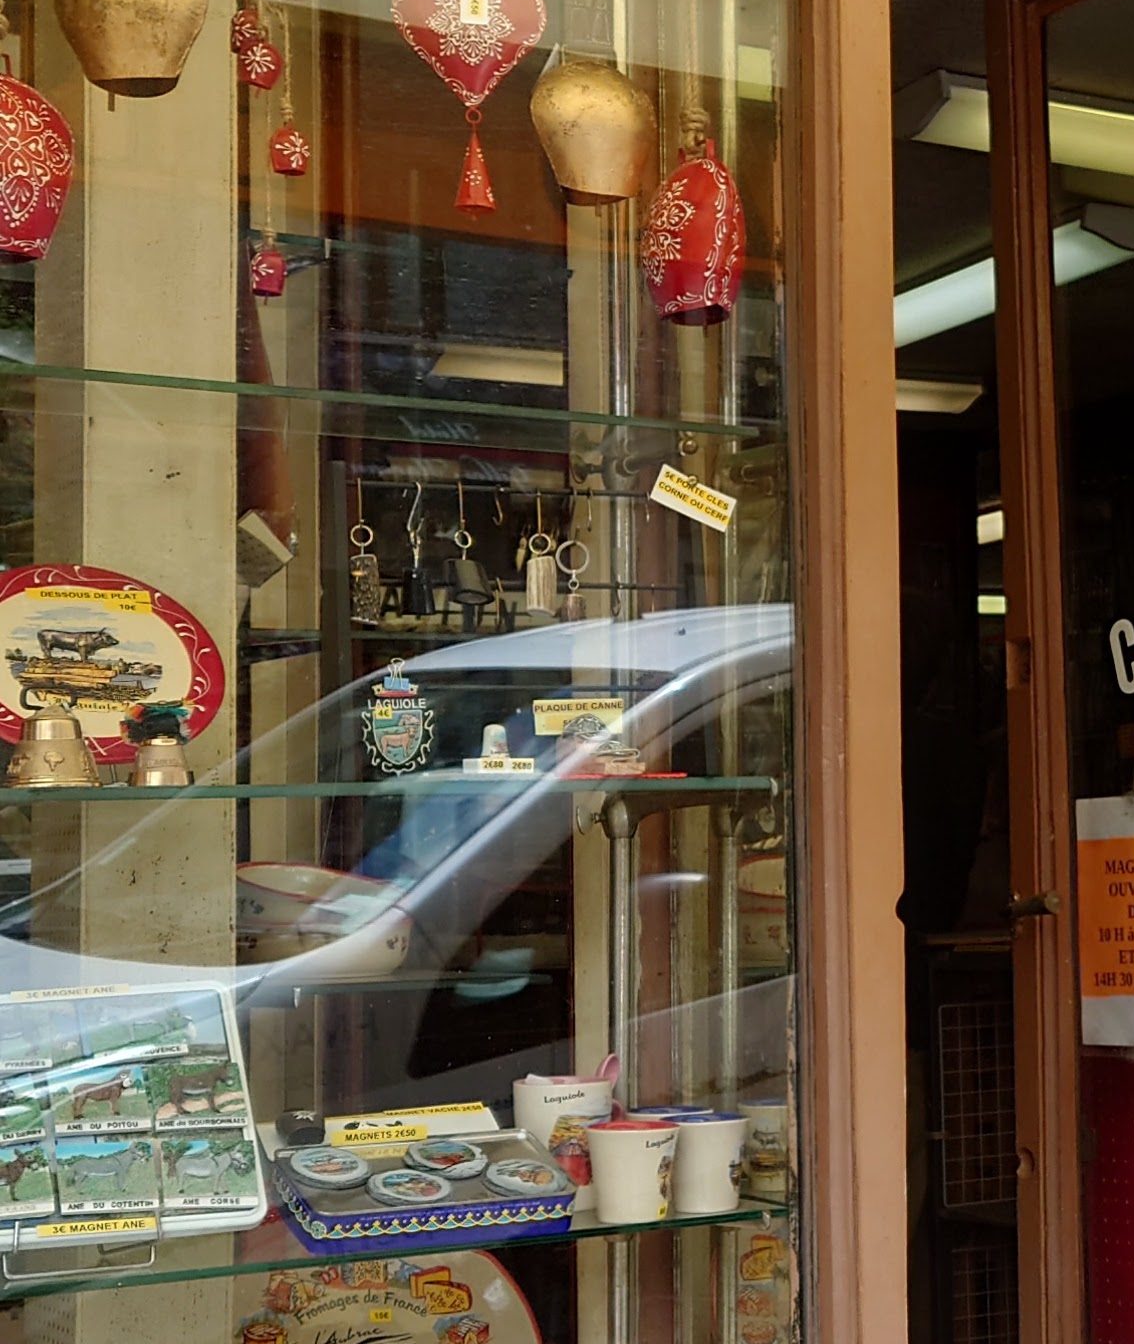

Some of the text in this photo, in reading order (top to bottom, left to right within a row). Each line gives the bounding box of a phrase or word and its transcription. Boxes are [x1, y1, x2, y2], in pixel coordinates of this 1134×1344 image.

[676, 477, 705, 498] PORTE
[706, 494, 729, 510] CLES
[658, 481, 729, 523] CORNE OU CERF
[40, 590, 137, 600] DESSOUS DE PLAT
[367, 698, 427, 710] LAGUIOLE
[534, 700, 624, 713] PLAQUE DE CANNE
[377, 709, 390, 718] 4€
[483, 759, 504, 769] 2€80
[1099, 927, 1111, 942] 10
[1114, 927, 1125, 942] H
[1094, 972, 1117, 987] 14H
[1120, 972, 1133, 987] 30
[42, 987, 89, 998] MAGNET
[92, 985, 116, 994] ANE
[543, 1090, 585, 1105] Laguiole
[90, 1122, 102, 1130] DU
[107, 1120, 139, 1129] POITOU
[344, 1128, 416, 1142] MAGNETS 2€50
[67, 1202, 84, 1211] ANE
[93, 1201, 105, 1209] DU
[182, 1197, 241, 1206] ANE CORSE
[53, 1220, 146, 1234] 3€ MAGNET ANE
[293, 1291, 360, 1326] Fromages
[363, 1288, 380, 1305] de
[384, 1291, 428, 1318] France
